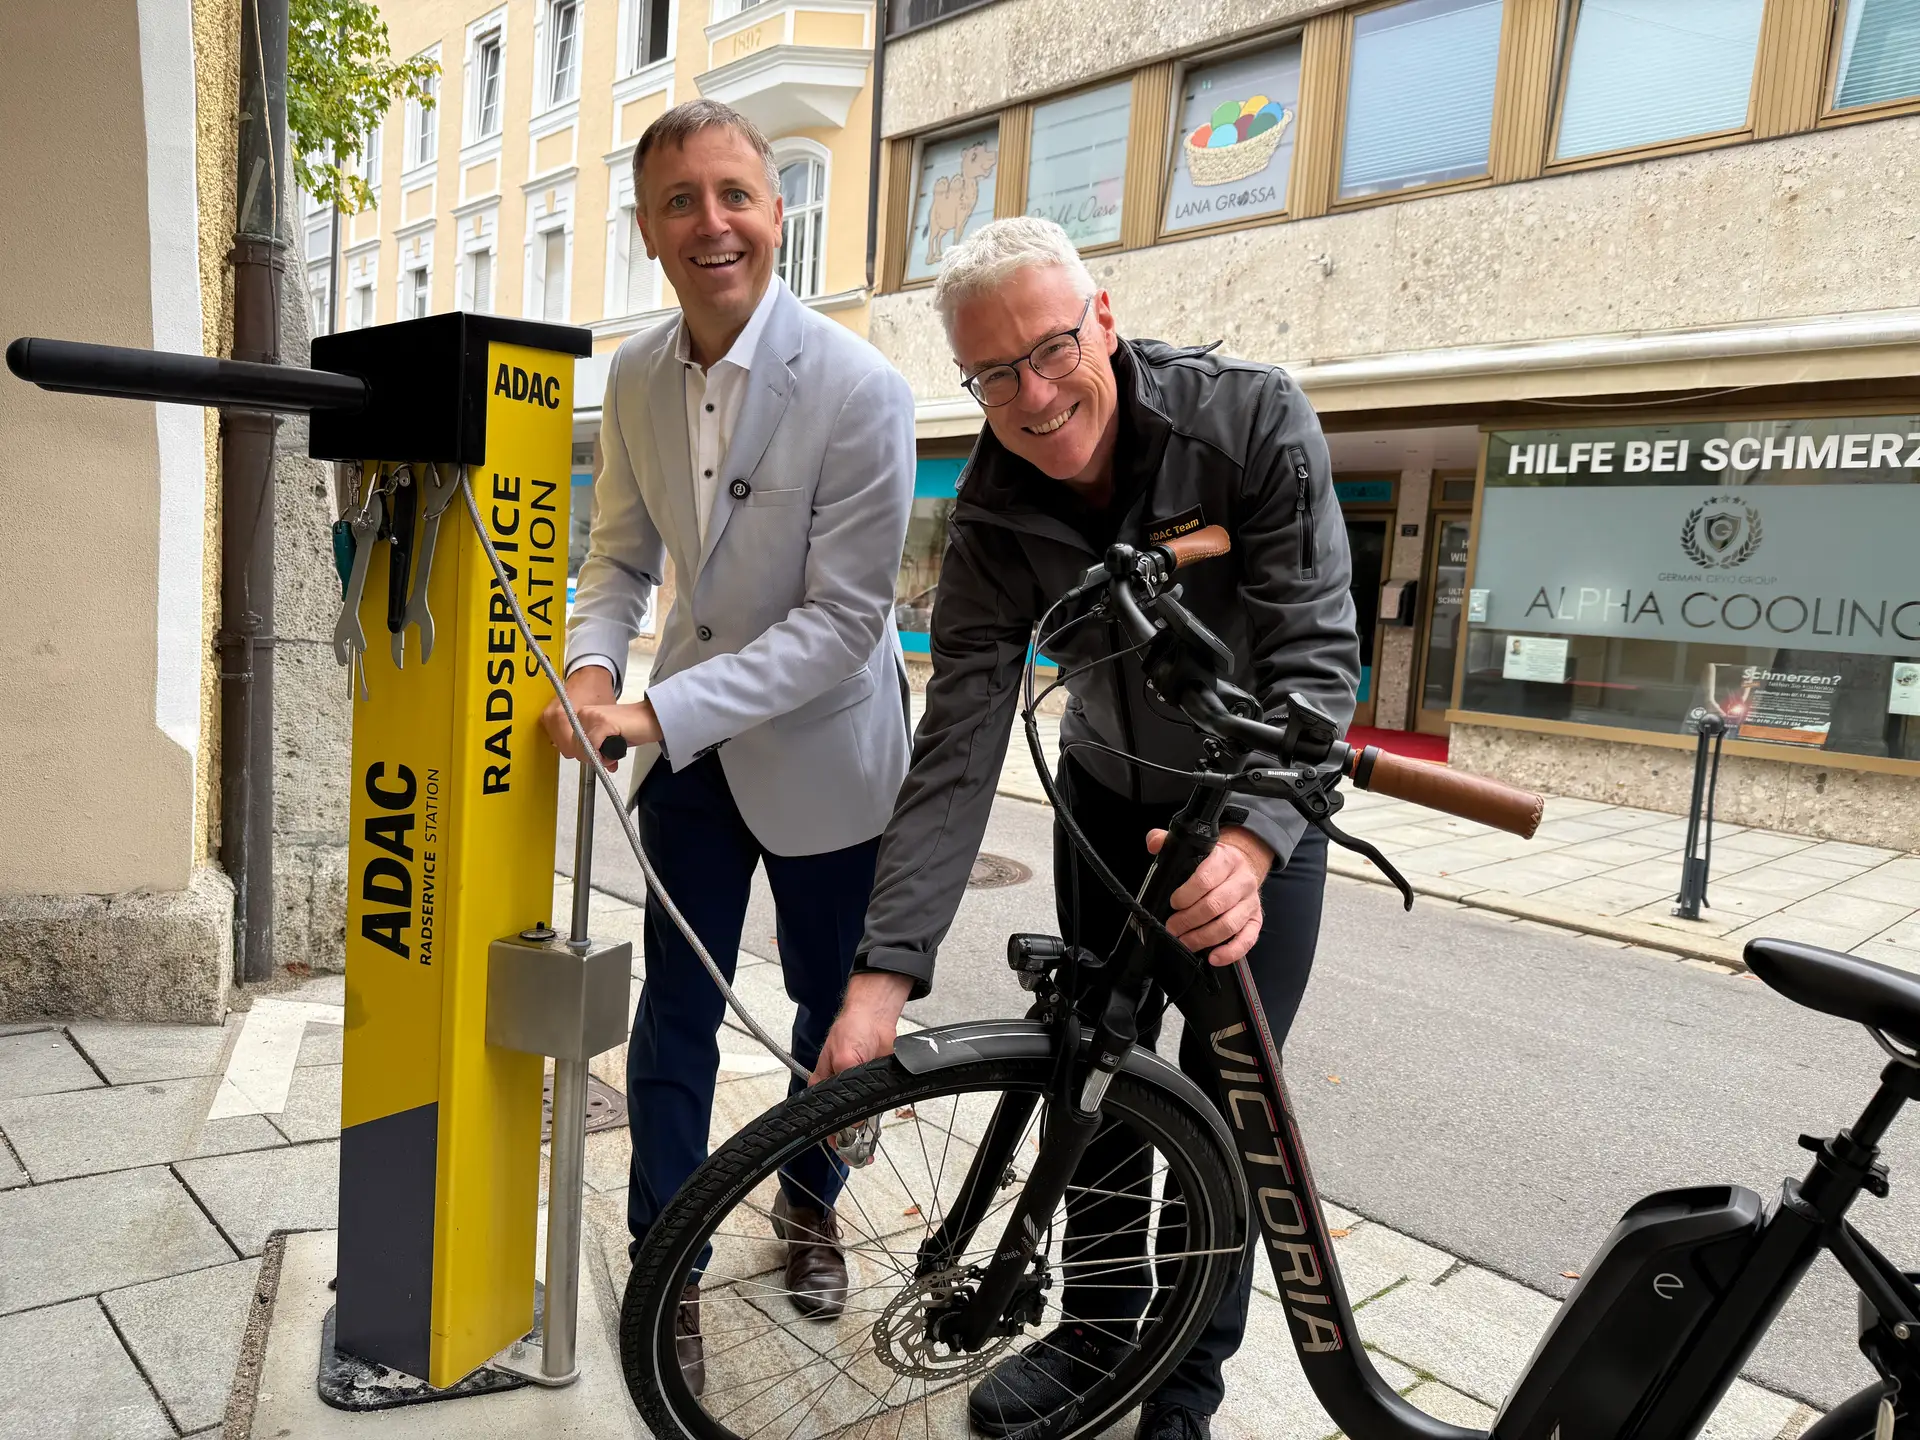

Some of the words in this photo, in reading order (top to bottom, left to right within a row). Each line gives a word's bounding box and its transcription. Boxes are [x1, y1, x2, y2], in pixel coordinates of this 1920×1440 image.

[1175, 198, 1211, 219] LANA
[494, 363, 560, 410] ADAC
[1508, 442, 1616, 475] HILFE
[1623, 439, 1690, 473] BEI
[1149, 528, 1173, 541] ADAC
[1173, 518, 1199, 534] Team
[525, 479, 557, 678] STATION
[1658, 573, 1701, 582] GERMAN
[1738, 576, 1777, 585] GROUP
[483, 473, 521, 795] RADSERVICE
[1525, 587, 1664, 626] ALPHA
[1681, 592, 1920, 641] COOLING
[1742, 667, 1841, 685] Schmerzen?
[425, 768, 439, 843] STATION
[362, 762, 417, 959] ADAC
[421, 851, 436, 965] RADSERVICE
[833, 1104, 868, 1122] TOUR
[1210, 1022, 1343, 1352] VICTORIA
